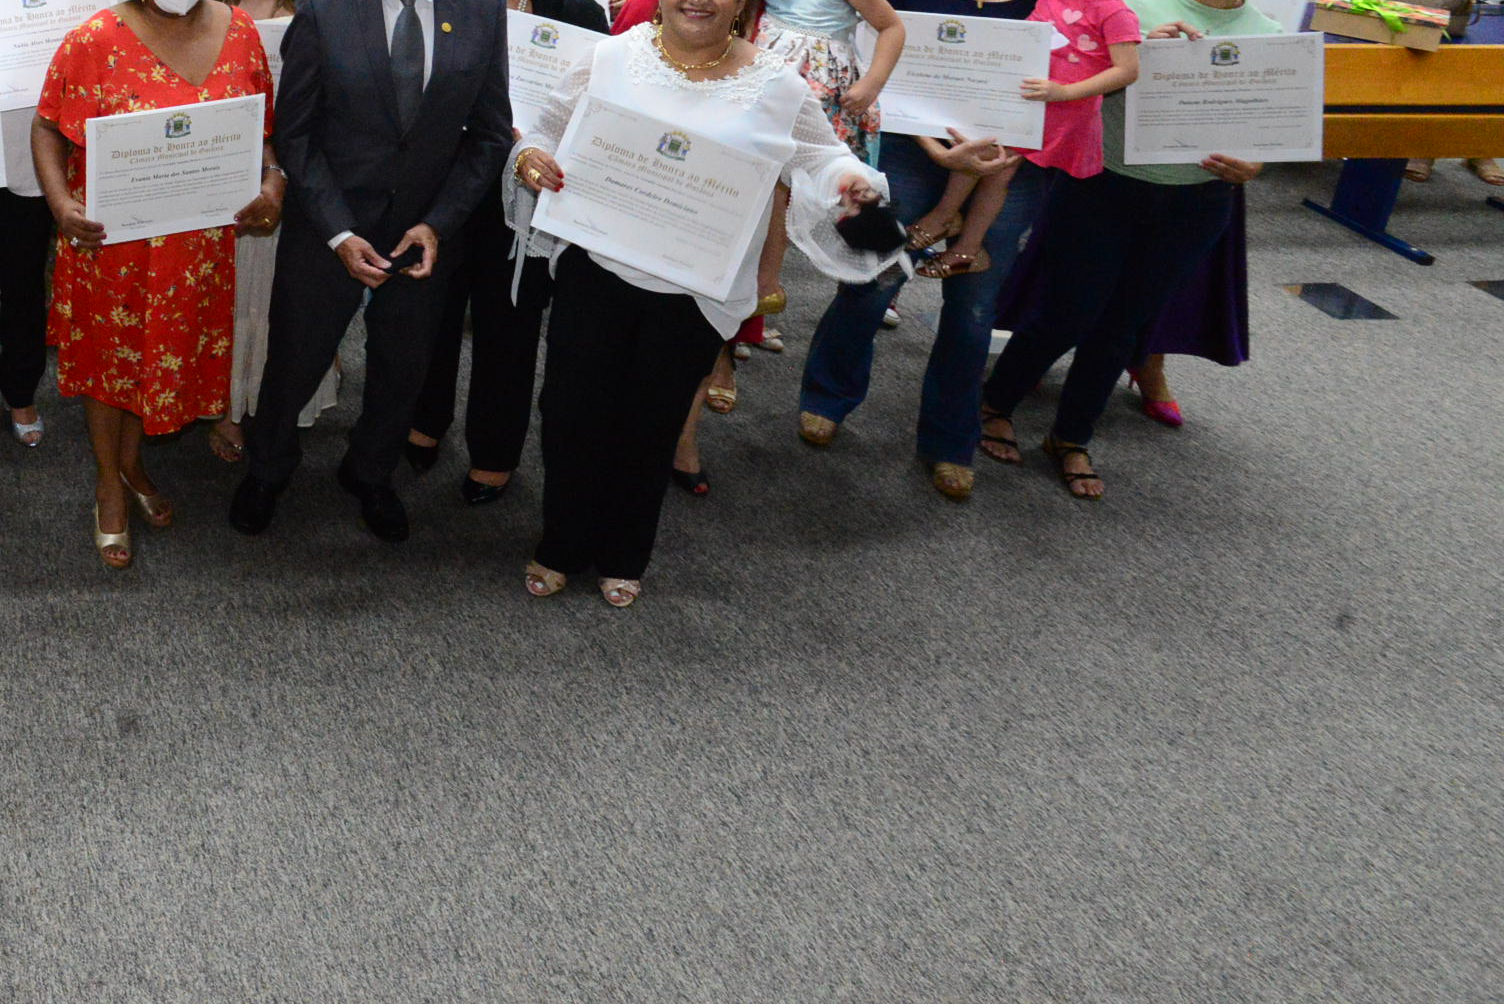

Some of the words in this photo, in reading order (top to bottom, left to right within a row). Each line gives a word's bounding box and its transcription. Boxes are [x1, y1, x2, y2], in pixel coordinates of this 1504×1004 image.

[15, 15, 24, 23] de
[26, 11, 53, 21] Honra
[67, 4, 97, 15] Mérito
[111, 148, 150, 159] Diploma
[153, 145, 163, 153] de
[165, 141, 195, 151] Honra
[210, 134, 241, 145] Mérito
[592, 138, 636, 160] Diploma
[639, 155, 651, 165] de
[653, 159, 687, 179] Honra
[689, 174, 701, 184] ao
[703, 178, 740, 198] Mérito
